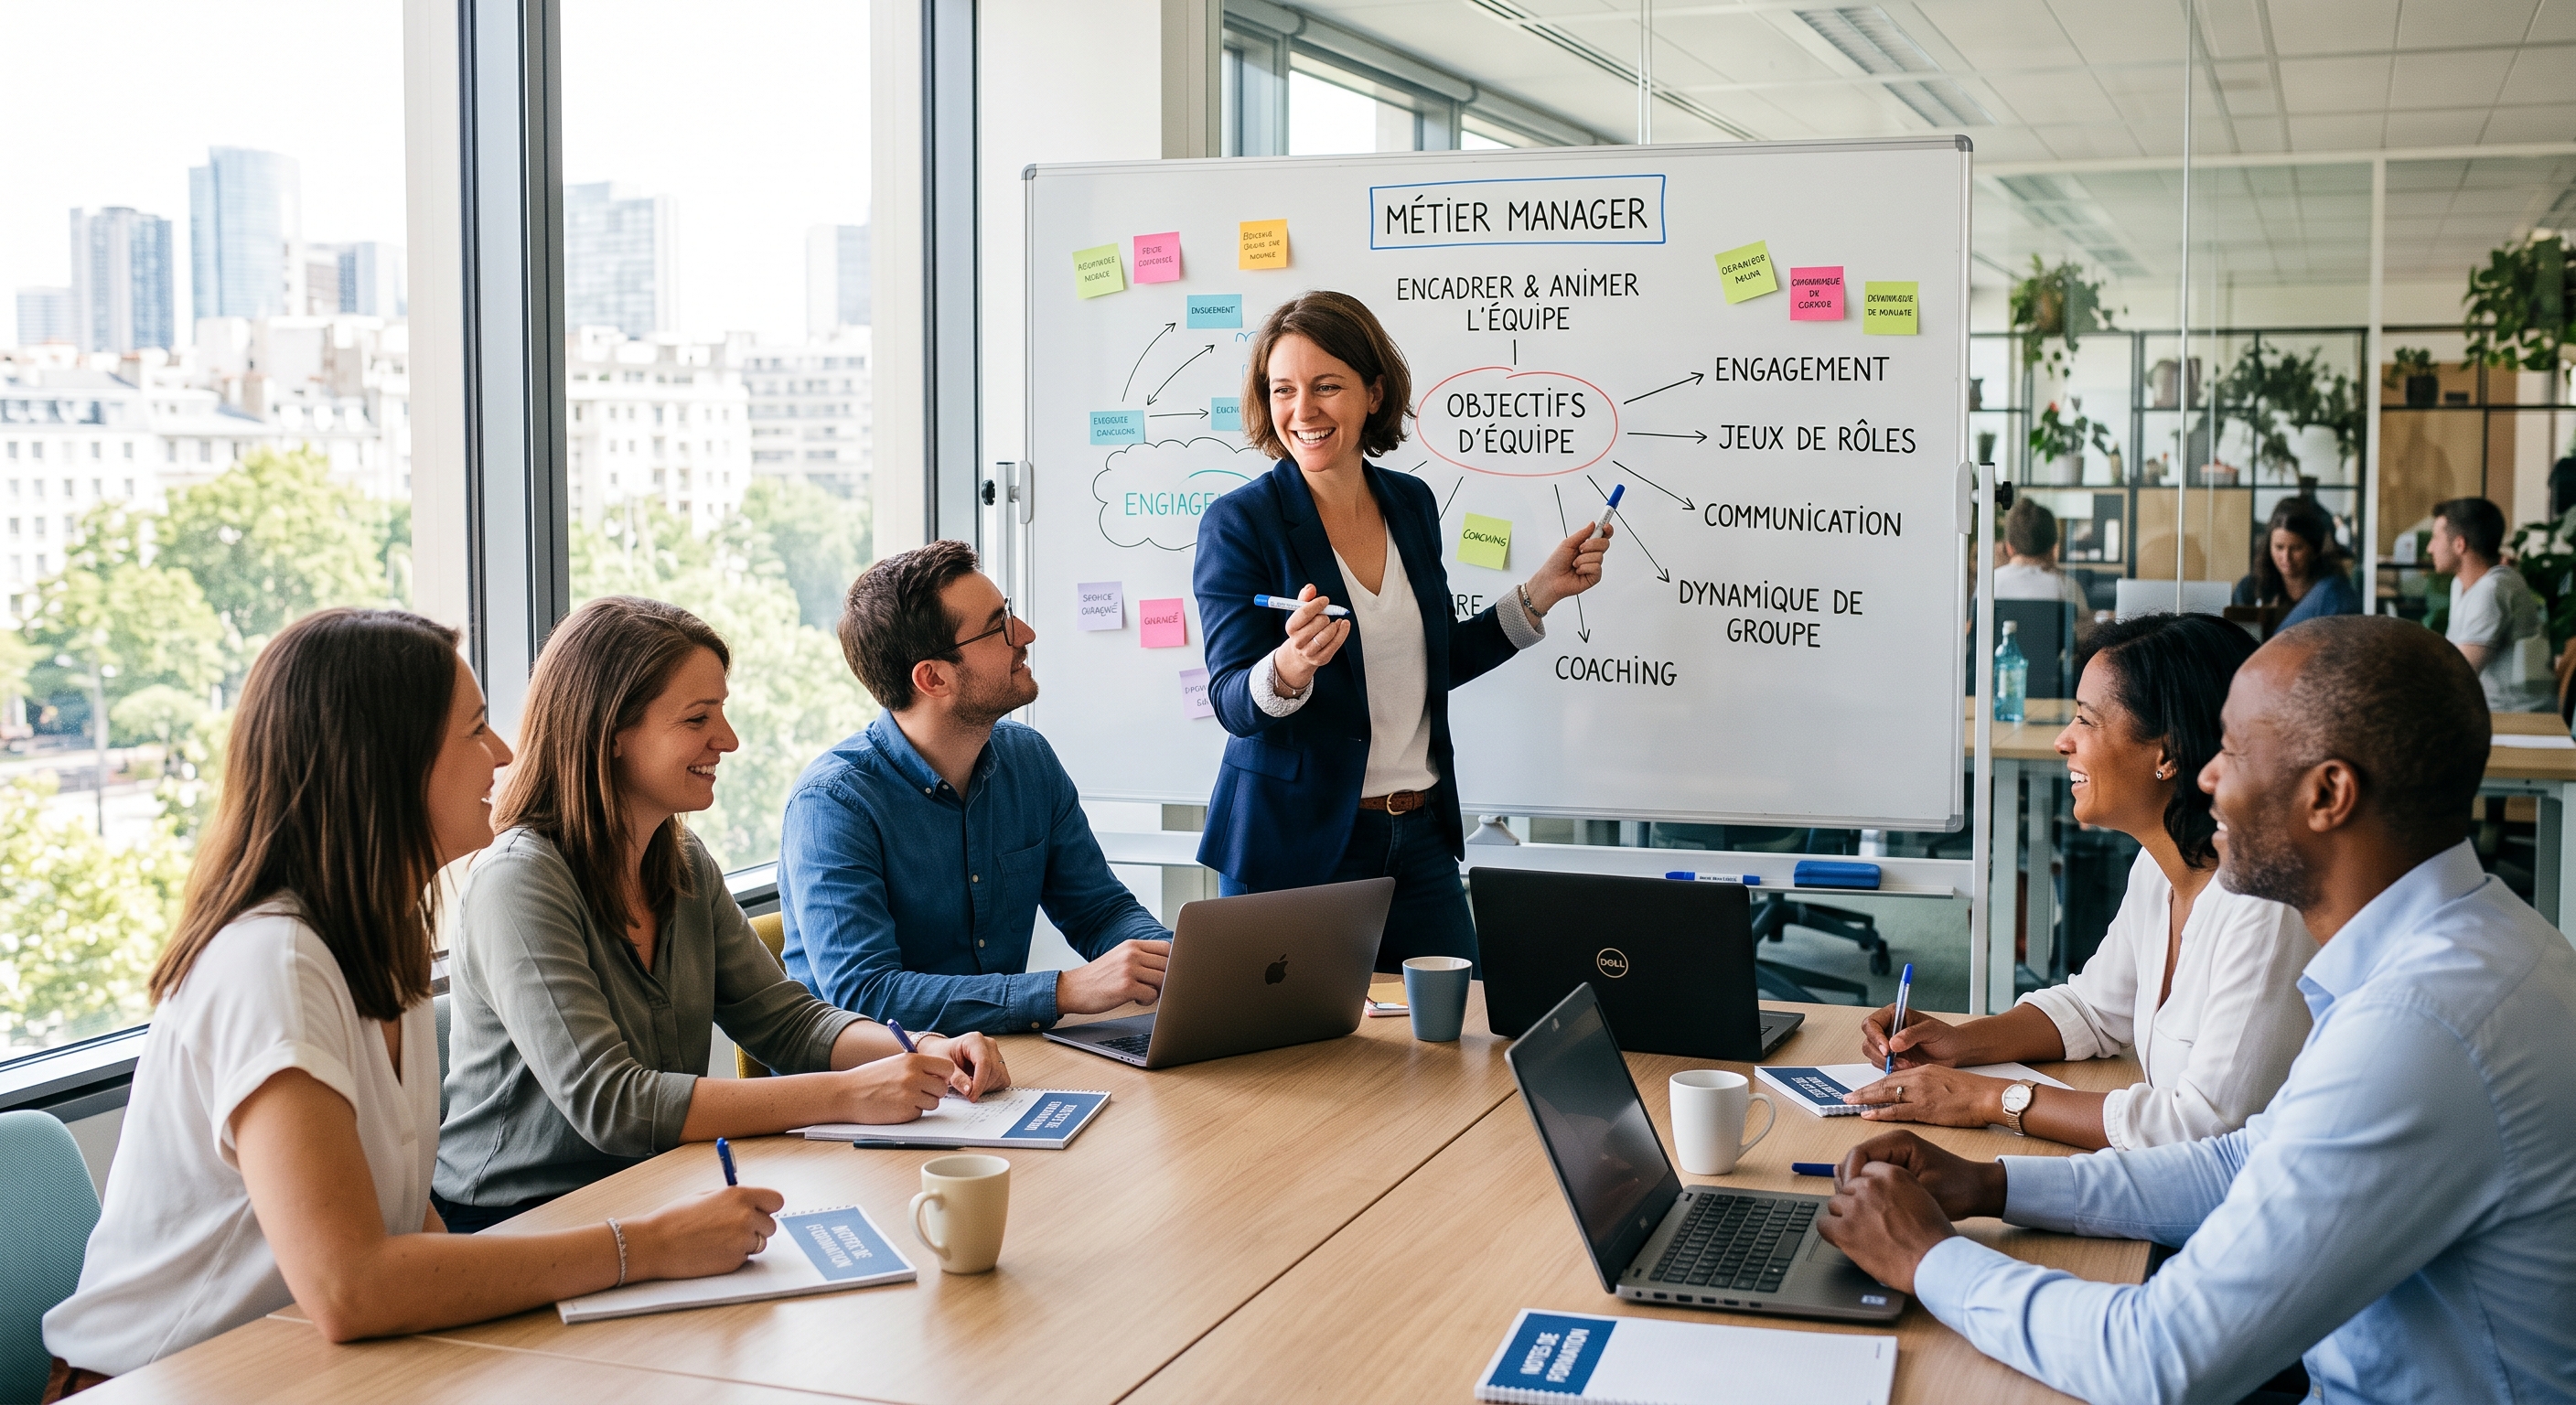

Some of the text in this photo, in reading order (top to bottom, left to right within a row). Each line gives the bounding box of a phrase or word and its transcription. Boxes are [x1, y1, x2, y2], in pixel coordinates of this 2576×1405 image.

[1386, 194, 1648, 235] MÉTIER MANAGER
[1396, 267, 1640, 301] ENCADRER & ANIMER
[1466, 301, 1571, 332] L'ÉQUIPE
[1715, 356, 1890, 382] ENGAGEMENT
[1446, 387, 1586, 418] OBJECTIFS
[1458, 423, 1575, 455] D'ÉQUIPE
[1719, 418, 1917, 454] JEUX DE RÔLES
[1703, 502, 1902, 537] COMMUNICATION
[1679, 579, 1863, 616] DYNAMIQUE DE
[1726, 617, 1821, 649] GROUPE
[1554, 654, 1678, 687] COACHING
[1599, 957, 1626, 970] DELL
